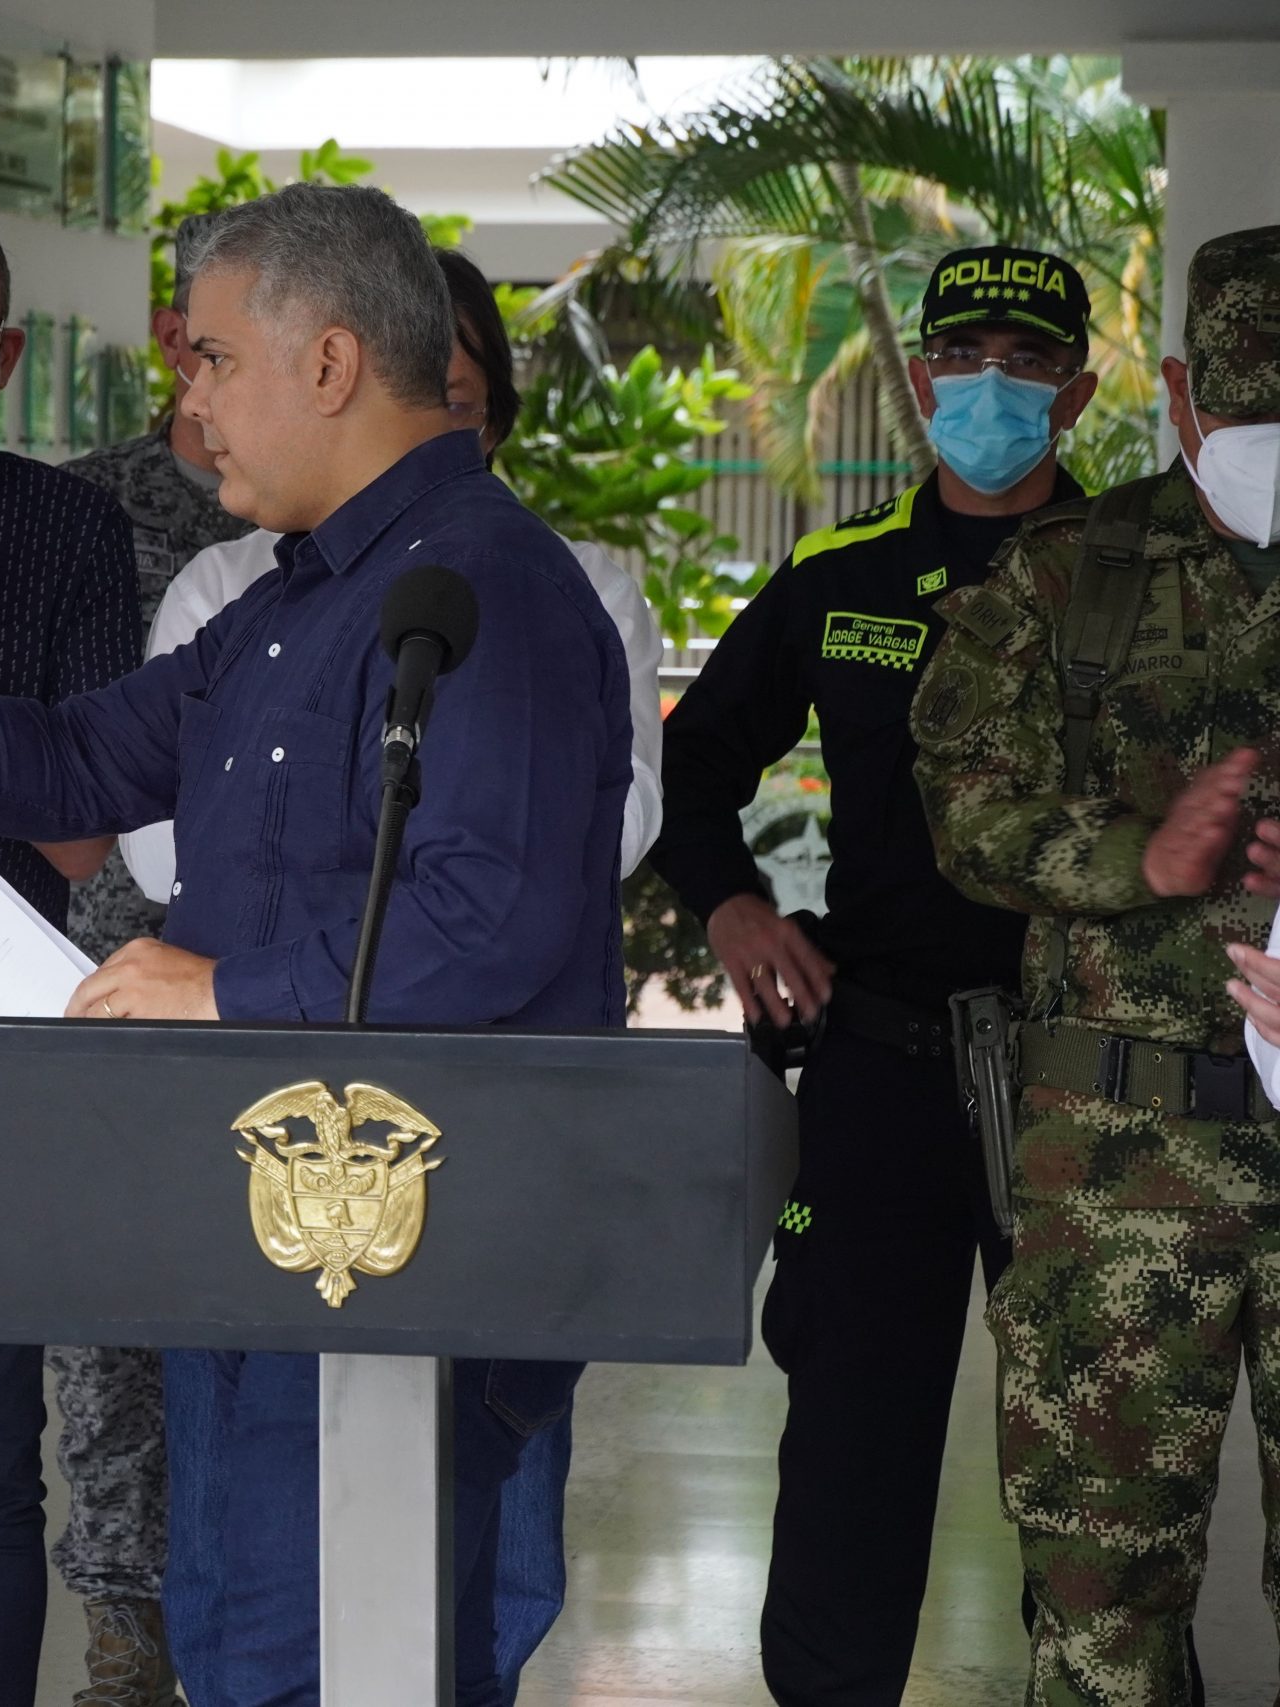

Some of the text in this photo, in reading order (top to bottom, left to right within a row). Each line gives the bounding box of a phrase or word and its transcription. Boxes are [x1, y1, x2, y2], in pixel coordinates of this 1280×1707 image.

[938, 257, 1067, 300] POLICÍA
[853, 620, 896, 635] General
[827, 630, 917, 652] JORGE VARGAS
